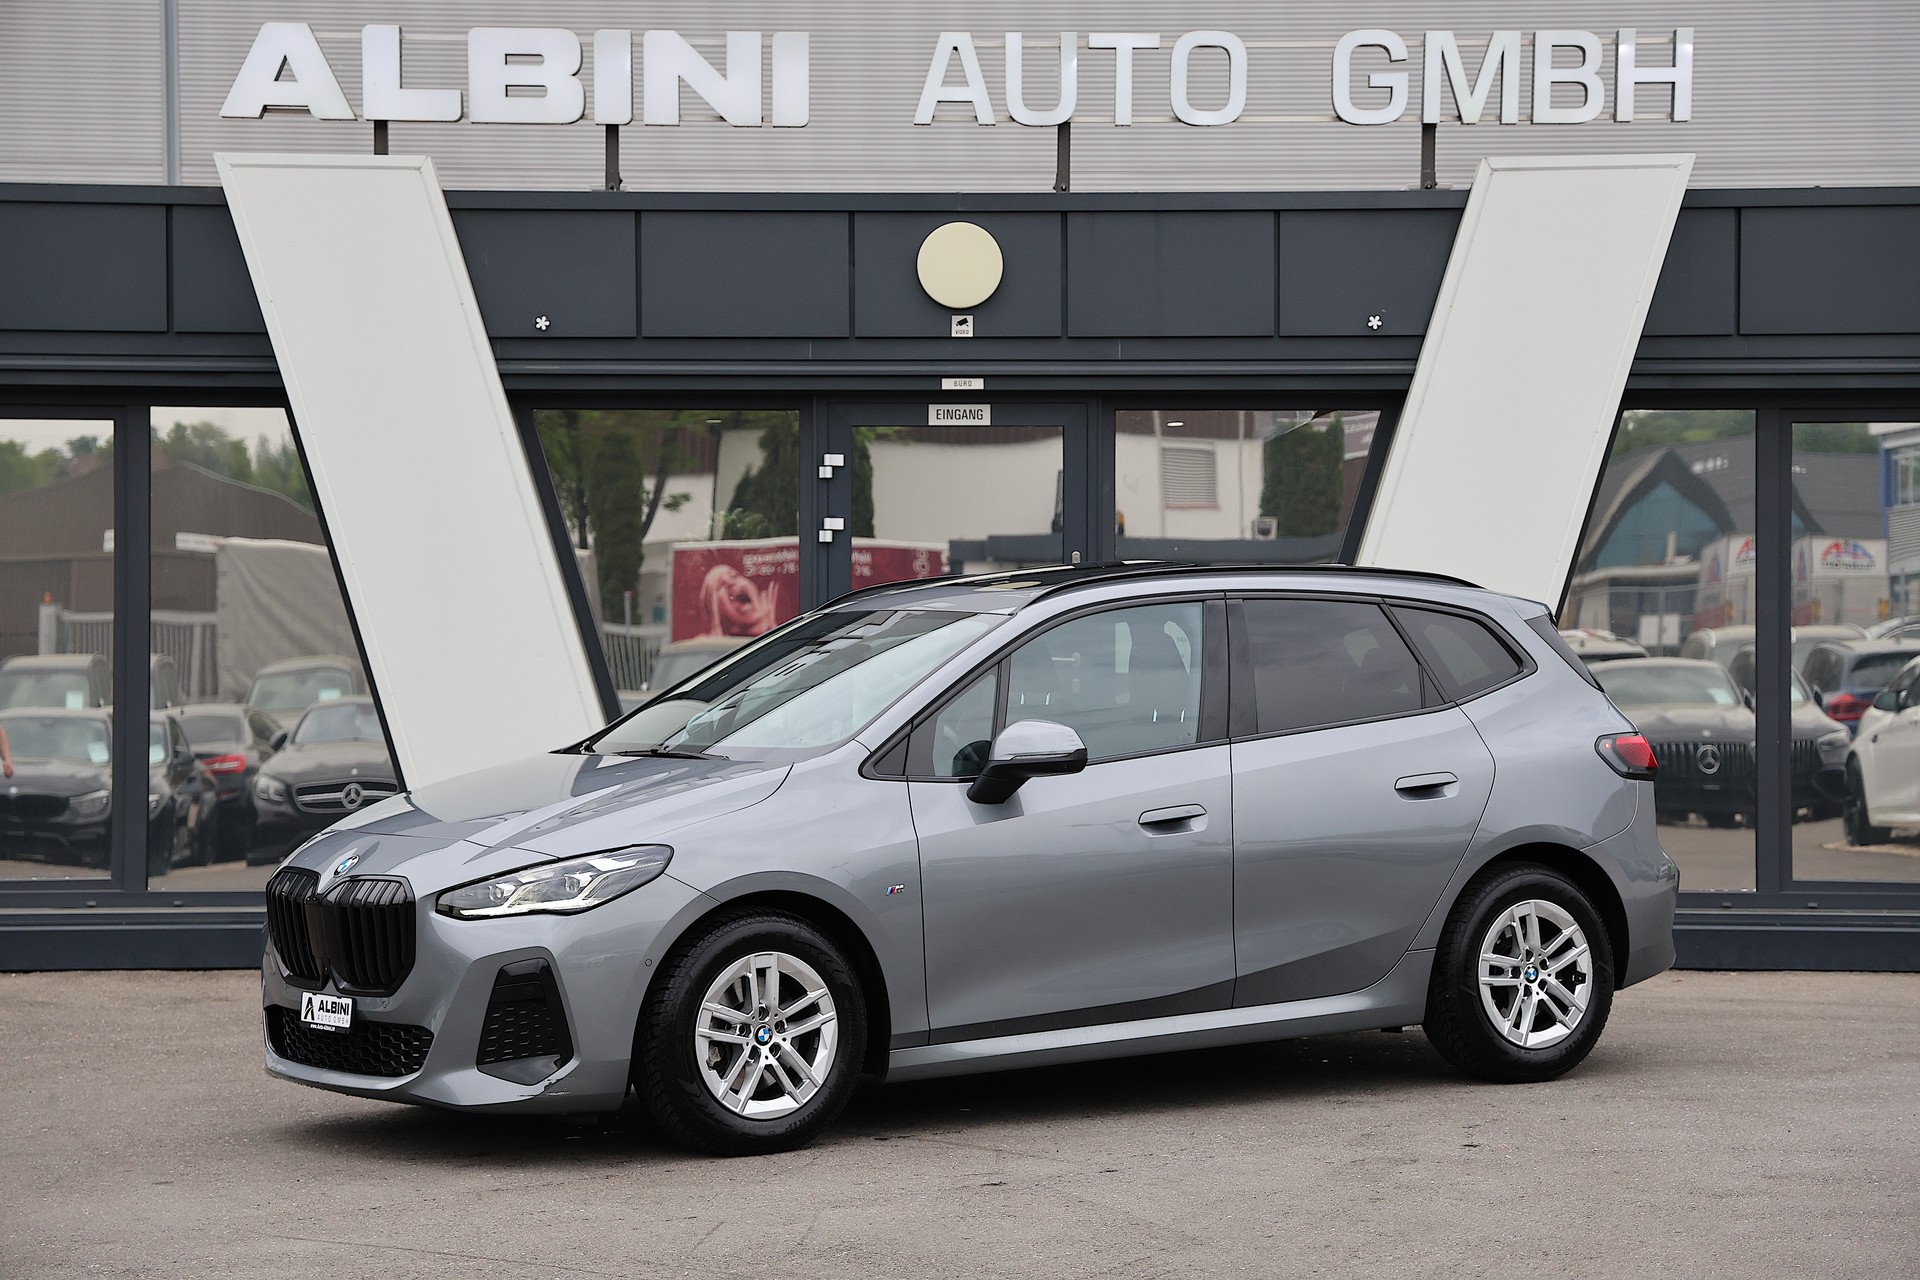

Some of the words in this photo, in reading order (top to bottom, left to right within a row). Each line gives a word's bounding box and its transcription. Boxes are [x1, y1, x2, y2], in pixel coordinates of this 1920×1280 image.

[219, 22, 811, 128] ALBINI
[913, 30, 1249, 127] AUTO
[1331, 28, 1694, 126] GMBH
[953, 379, 973, 387] BÜRO
[936, 408, 984, 420] EINGANG
[317, 999, 350, 1016] ALBINI
